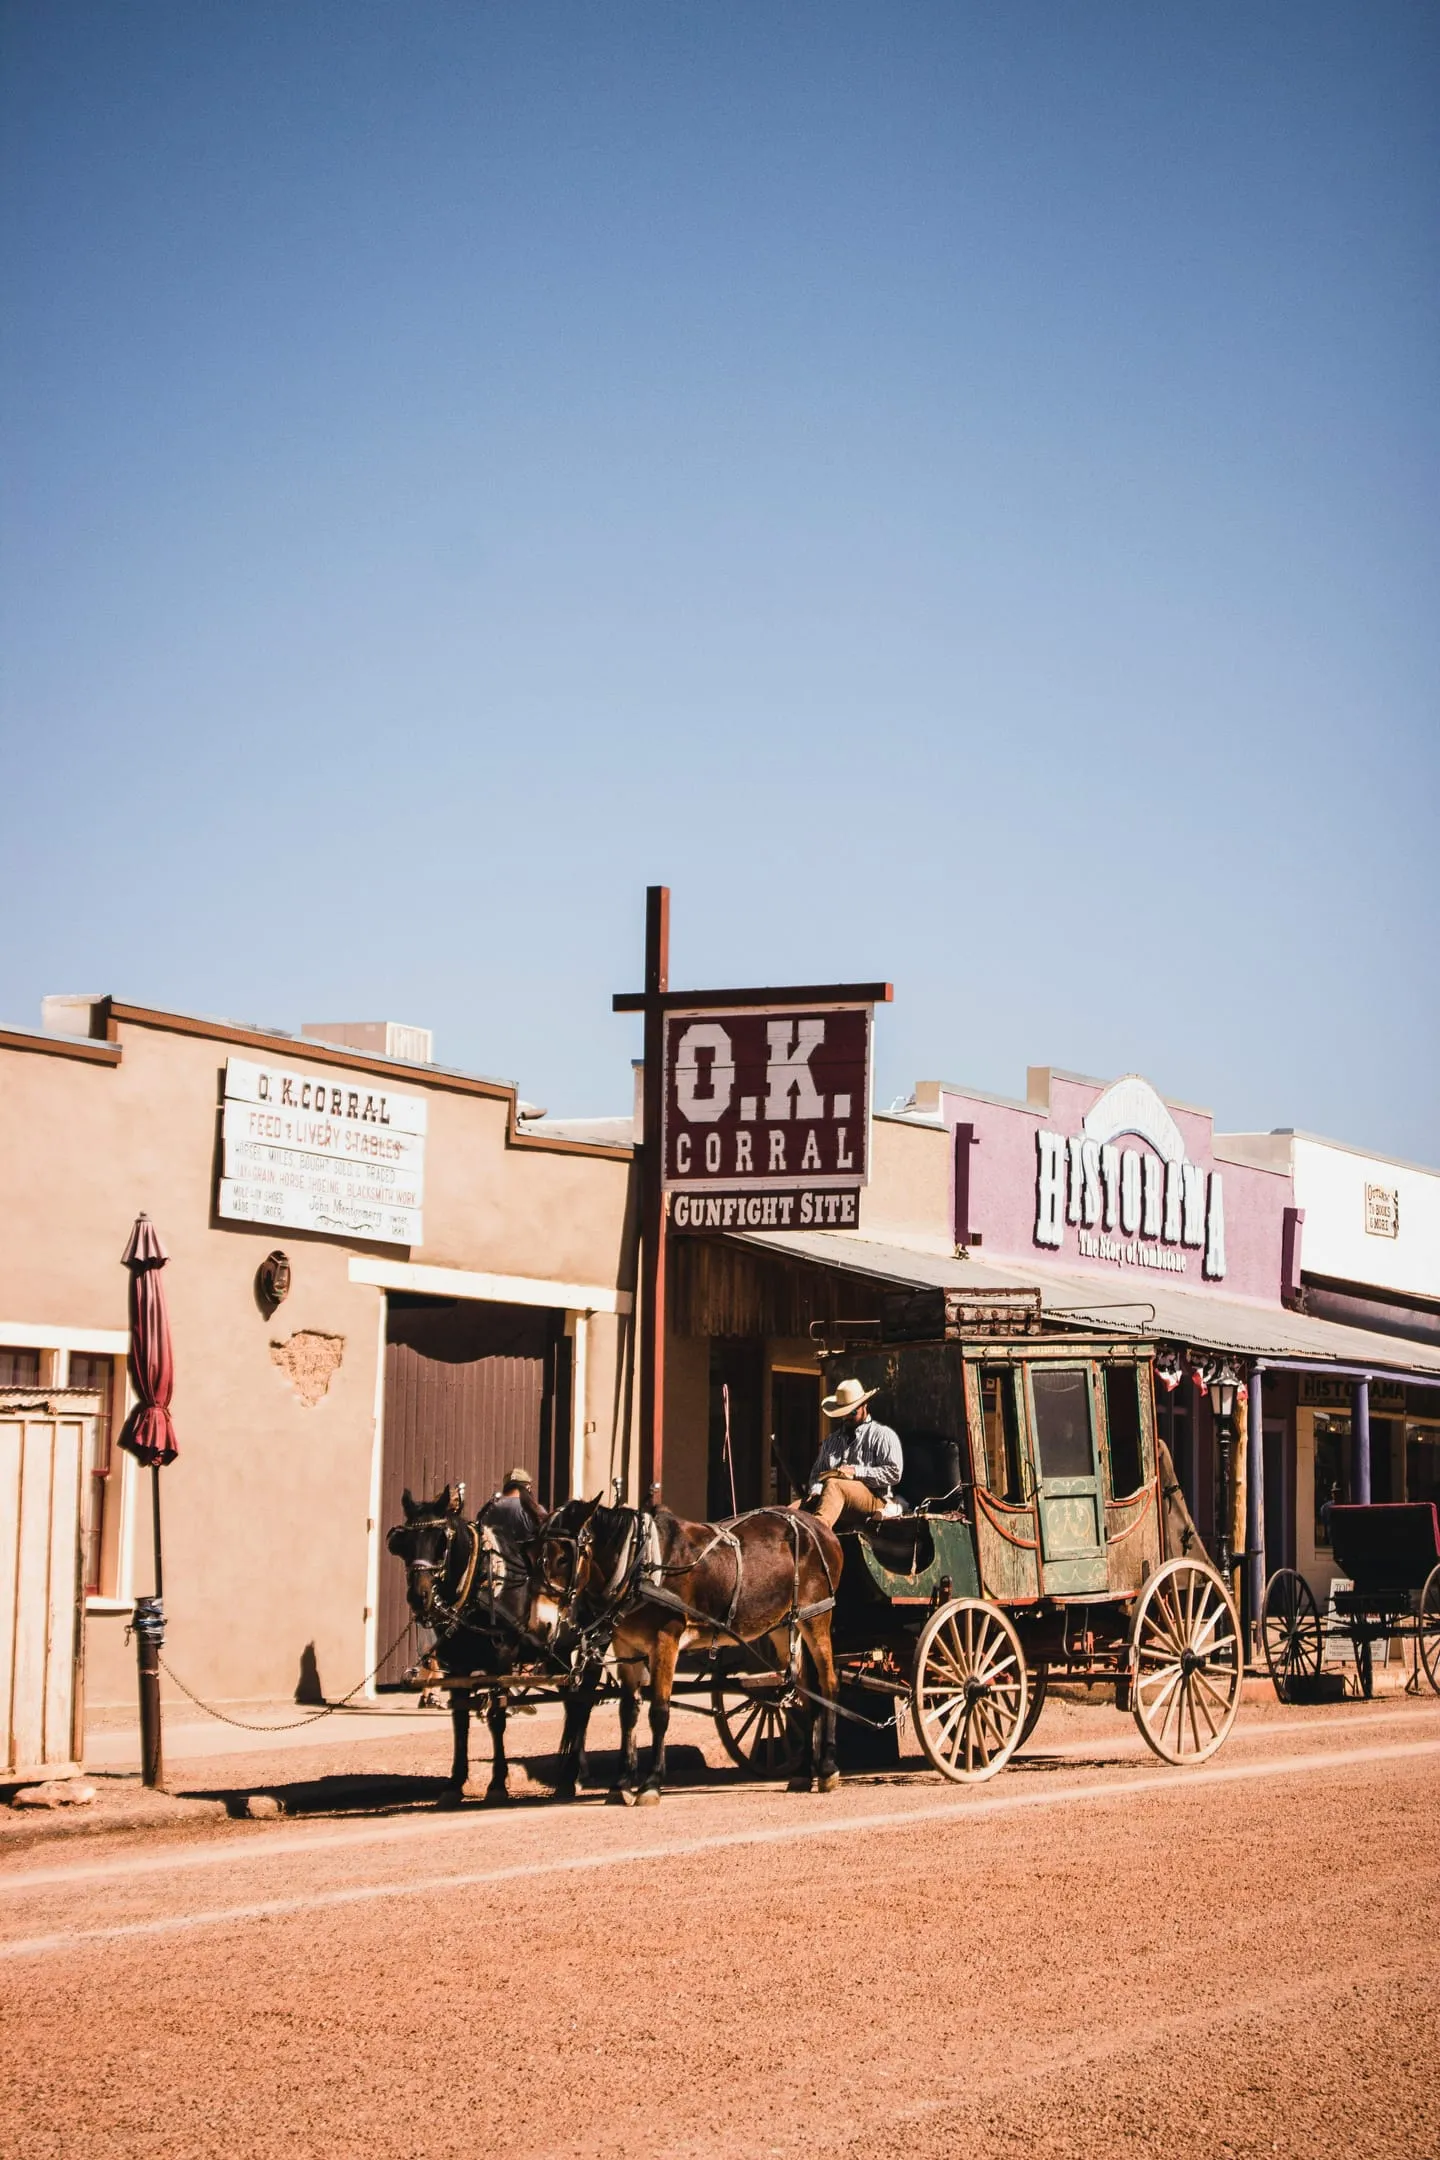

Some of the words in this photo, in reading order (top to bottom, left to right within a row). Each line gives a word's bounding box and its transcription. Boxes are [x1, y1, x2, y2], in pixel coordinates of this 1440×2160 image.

[675, 1019, 851, 1123] O.K.
[249, 1112, 282, 1138] FEED
[296, 1119, 340, 1147] LIVERY
[345, 1130, 401, 1160] STABLES
[676, 1127, 853, 1173] CORRAL
[279, 1174, 304, 1189] HORSE
[347, 1182, 394, 1202] BLACKSMITH
[397, 1191, 416, 1206] WORK
[308, 1194, 329, 1213] John
[1033, 1129, 1226, 1282] HISTORAMA
[1078, 1230, 1098, 1258] The
[1098, 1234, 1125, 1268] Story
[1126, 1242, 1138, 1266] of
[1136, 1241, 1187, 1273] Tombstone
[1304, 1374, 1405, 1400] HISTOAMA
